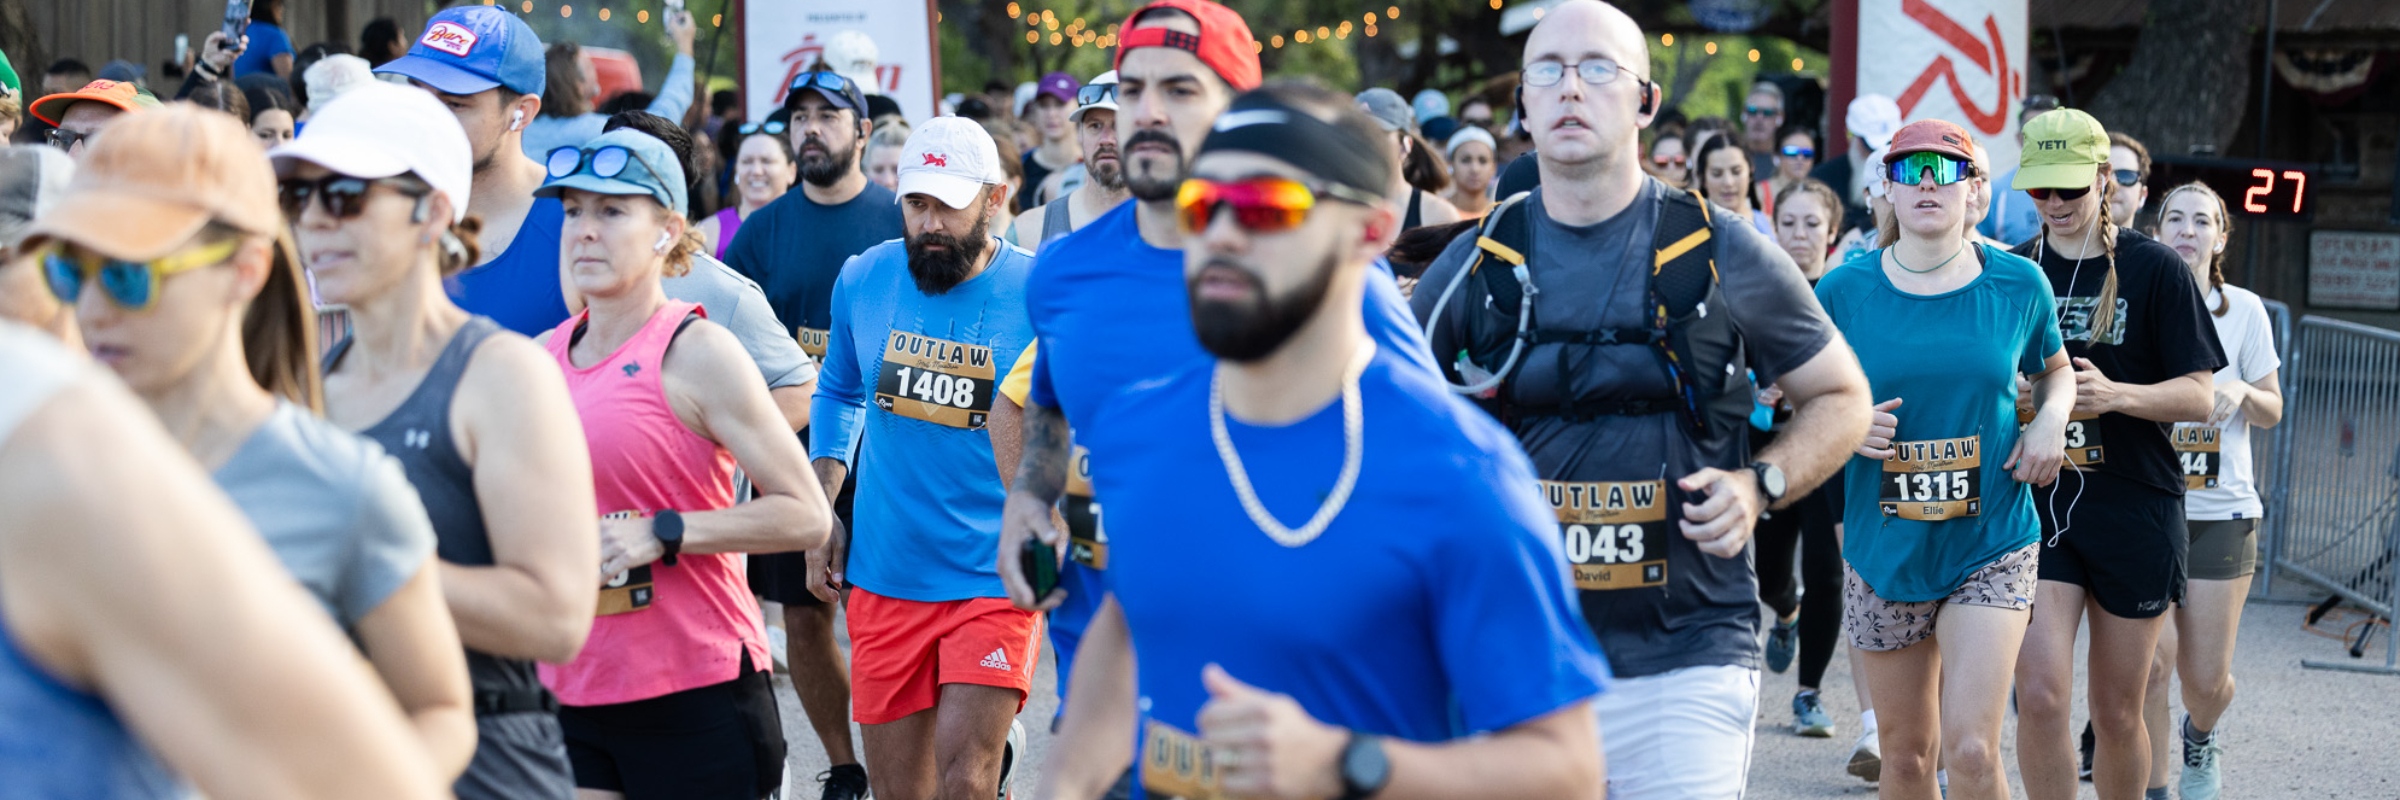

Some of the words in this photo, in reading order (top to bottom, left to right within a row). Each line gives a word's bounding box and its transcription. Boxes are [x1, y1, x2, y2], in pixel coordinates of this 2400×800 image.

[427, 25, 469, 44] Bare
[2037, 139, 2067, 150] YETI
[2244, 168, 2305, 213] 27
[894, 333, 990, 368] OUTLAW
[897, 366, 975, 408] 1408
[1894, 470, 1969, 501] 1315
[1923, 506, 1944, 515] Ellie
[1566, 524, 1645, 564] 043
[1574, 570, 1611, 581] David
[980, 659, 1011, 671] adidas
